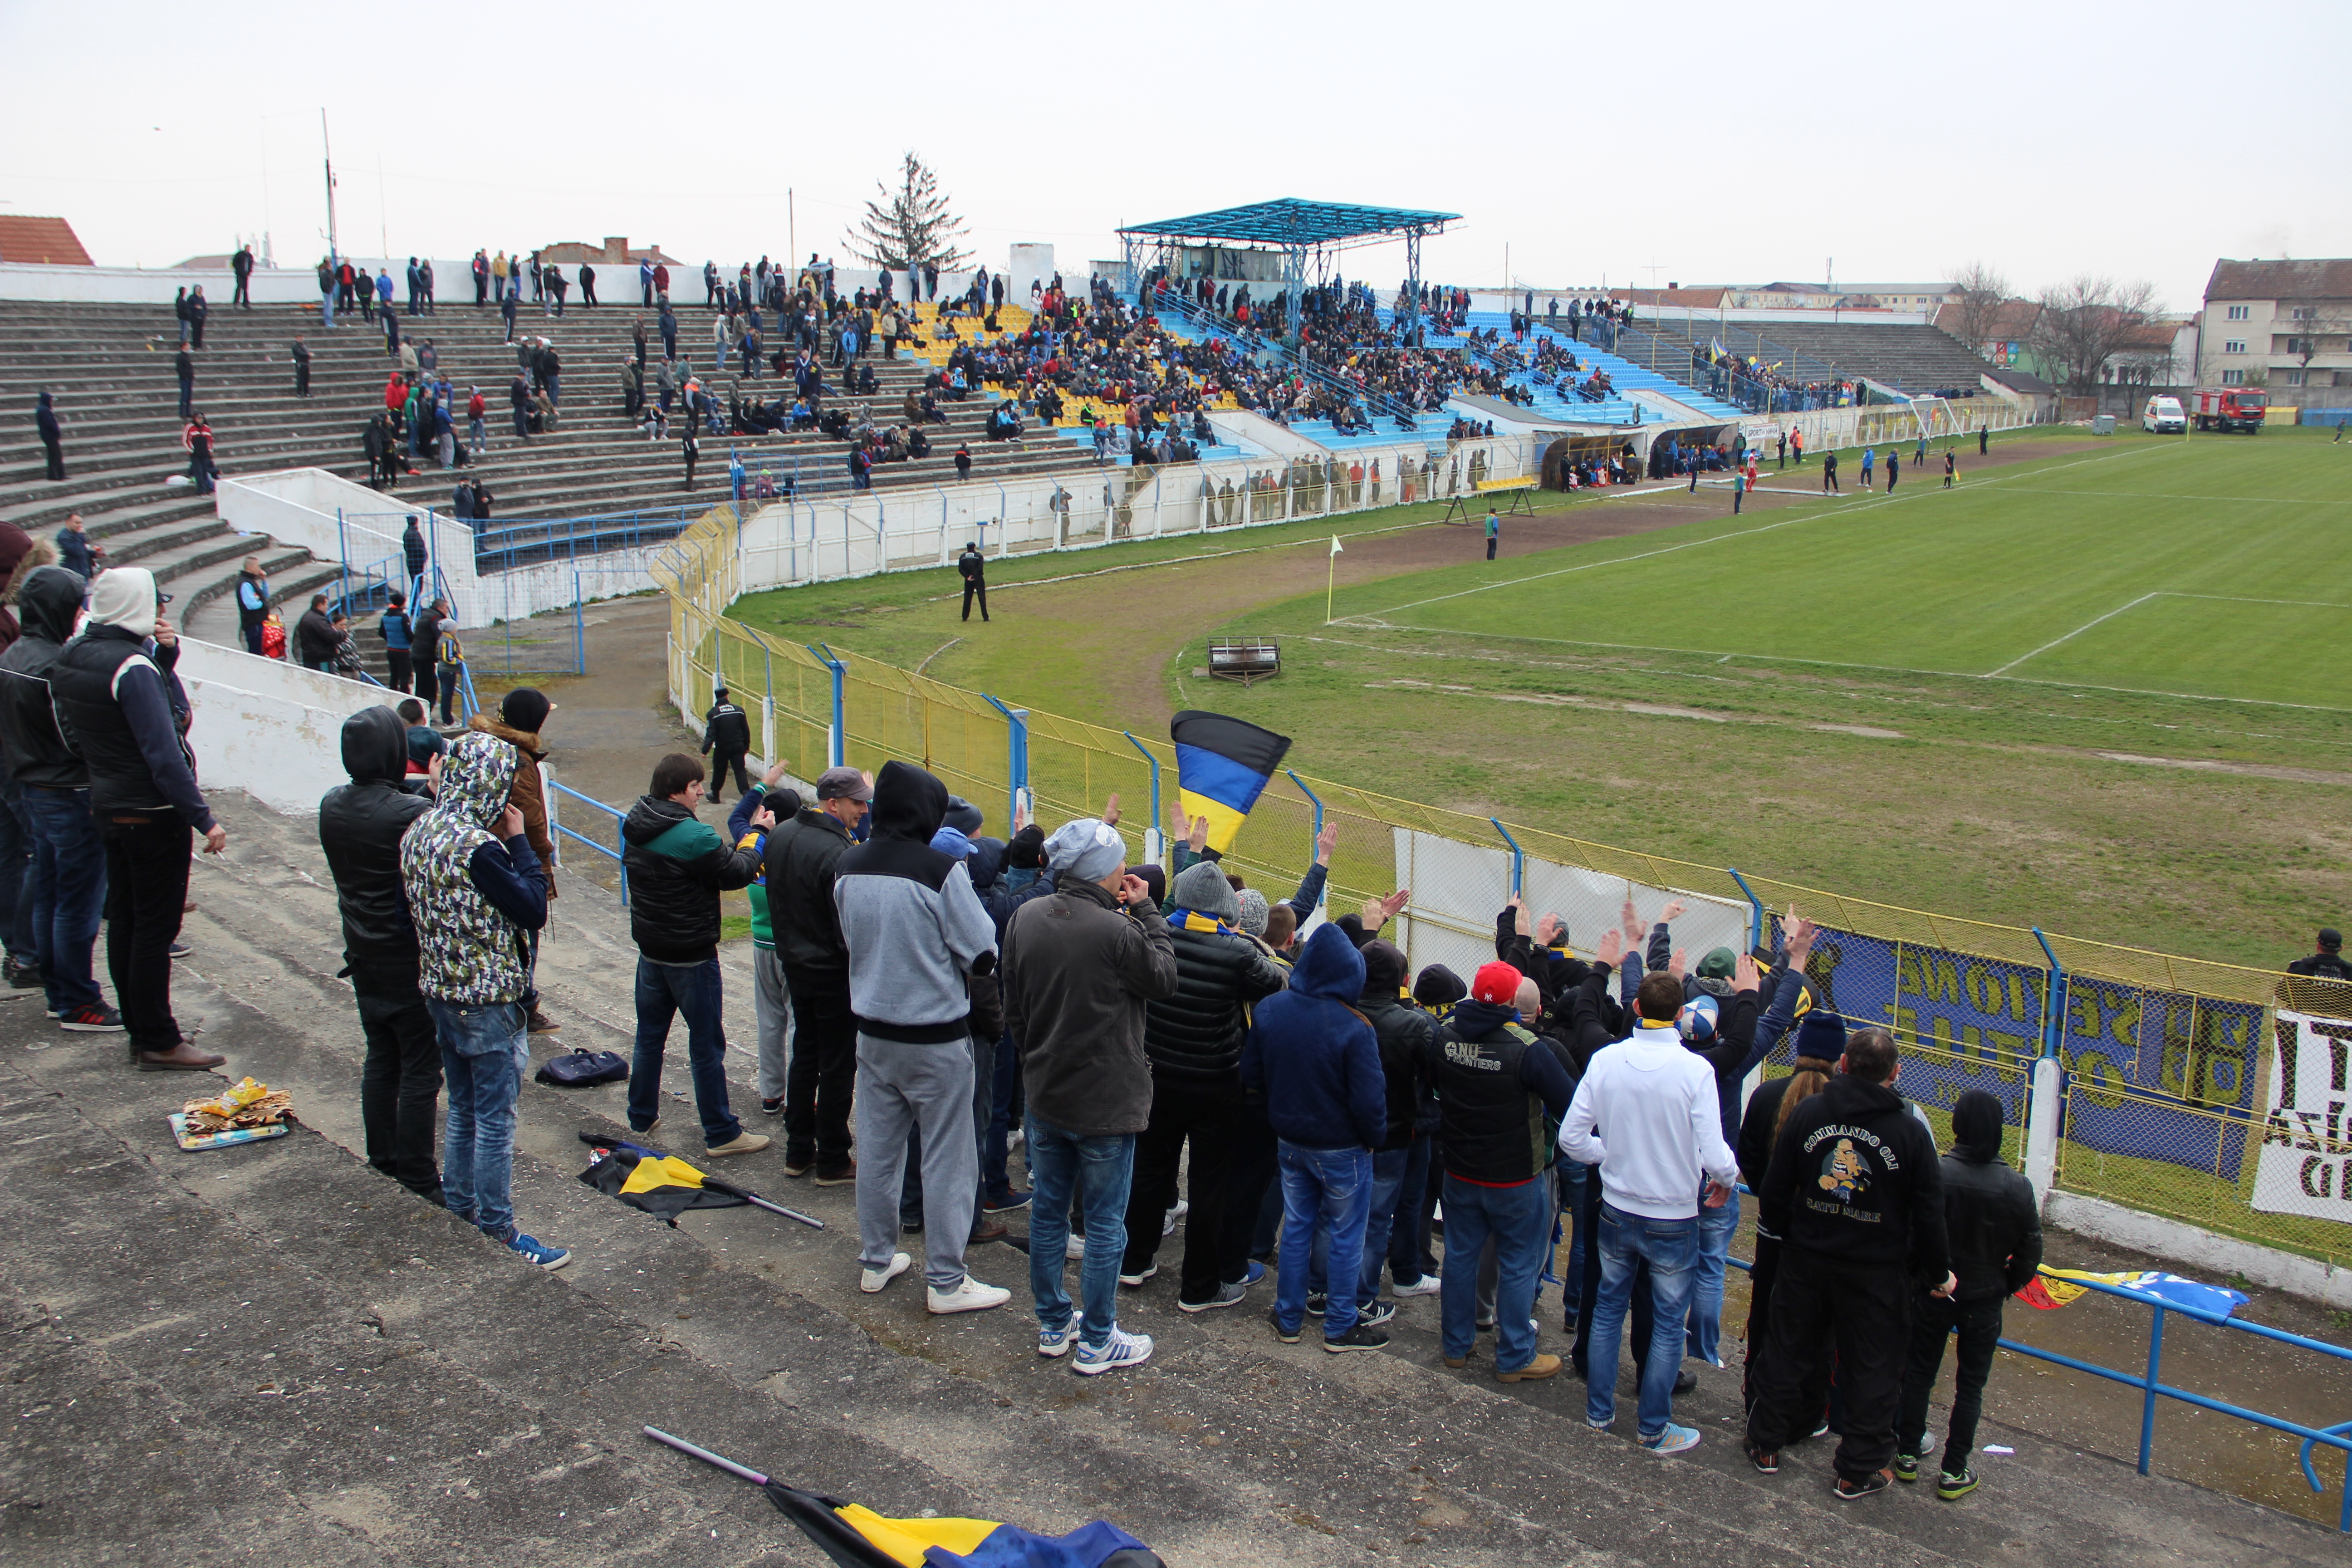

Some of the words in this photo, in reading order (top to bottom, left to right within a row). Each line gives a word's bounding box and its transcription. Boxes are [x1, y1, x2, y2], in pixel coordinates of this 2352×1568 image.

[1447, 1049, 1501, 1071] FRONTIERS
[1459, 1043, 1479, 1058] NO
[1804, 1125, 1880, 1153] COMMANDO
[1879, 1146, 1899, 1170] OLI
[1807, 1197, 1839, 1214] SATU
[1842, 1205, 1881, 1222] MARE
